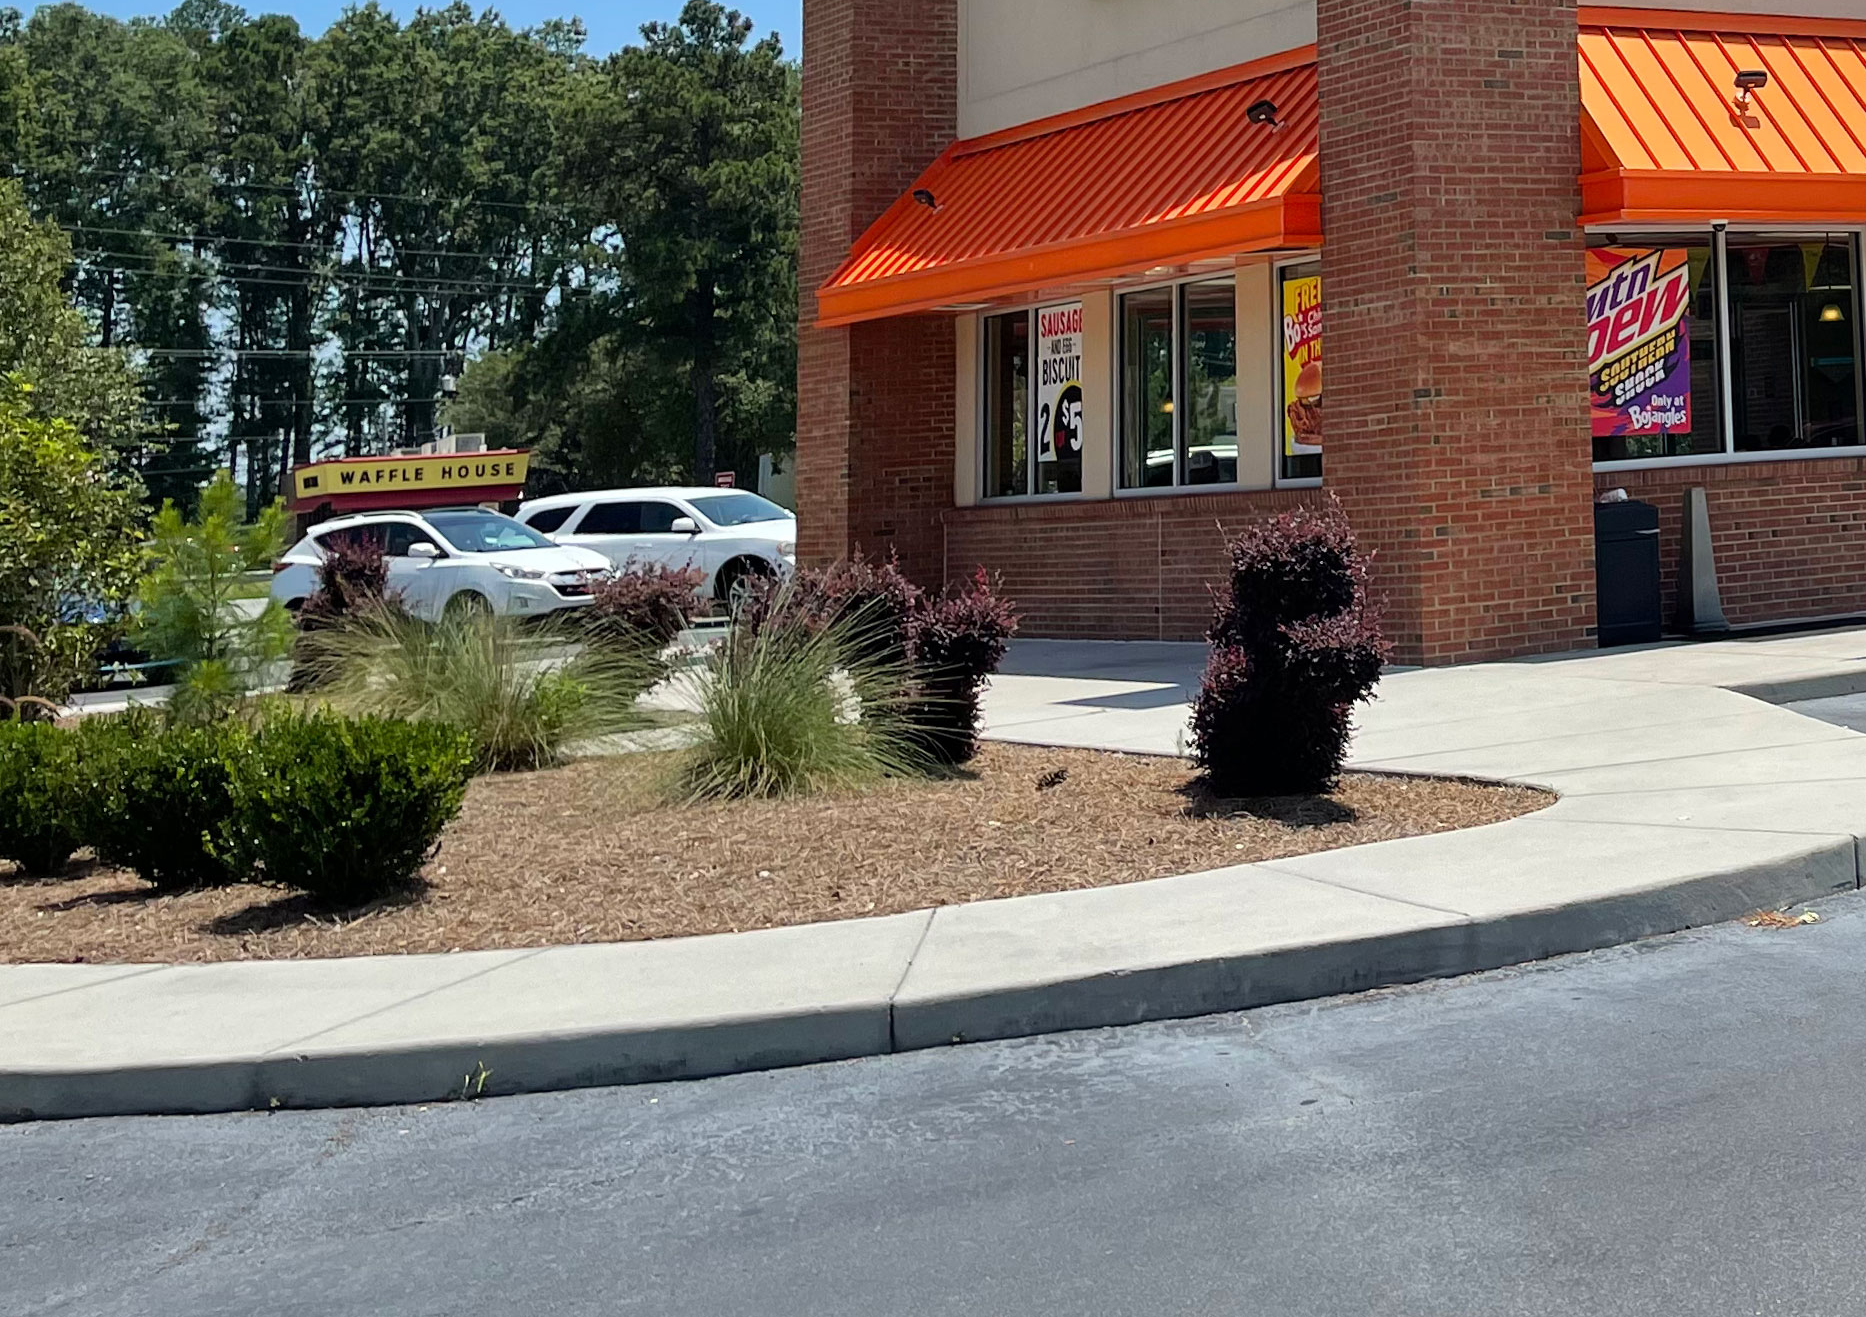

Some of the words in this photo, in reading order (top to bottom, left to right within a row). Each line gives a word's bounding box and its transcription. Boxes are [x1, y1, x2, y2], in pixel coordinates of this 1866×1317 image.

[1042, 355, 1081, 386] BISCUIT
[1600, 329, 1676, 392] SOUTHERN
[1615, 358, 1665, 406] SHOCK
[1627, 405, 1687, 430] Bojangles
[1651, 394, 1673, 410] Only
[1674, 395, 1685, 407] at
[1040, 403, 1051, 456] 2
[1062, 399, 1083, 451] $5
[340, 467, 424, 485] WAFFLE
[441, 462, 515, 480] HOUSE
